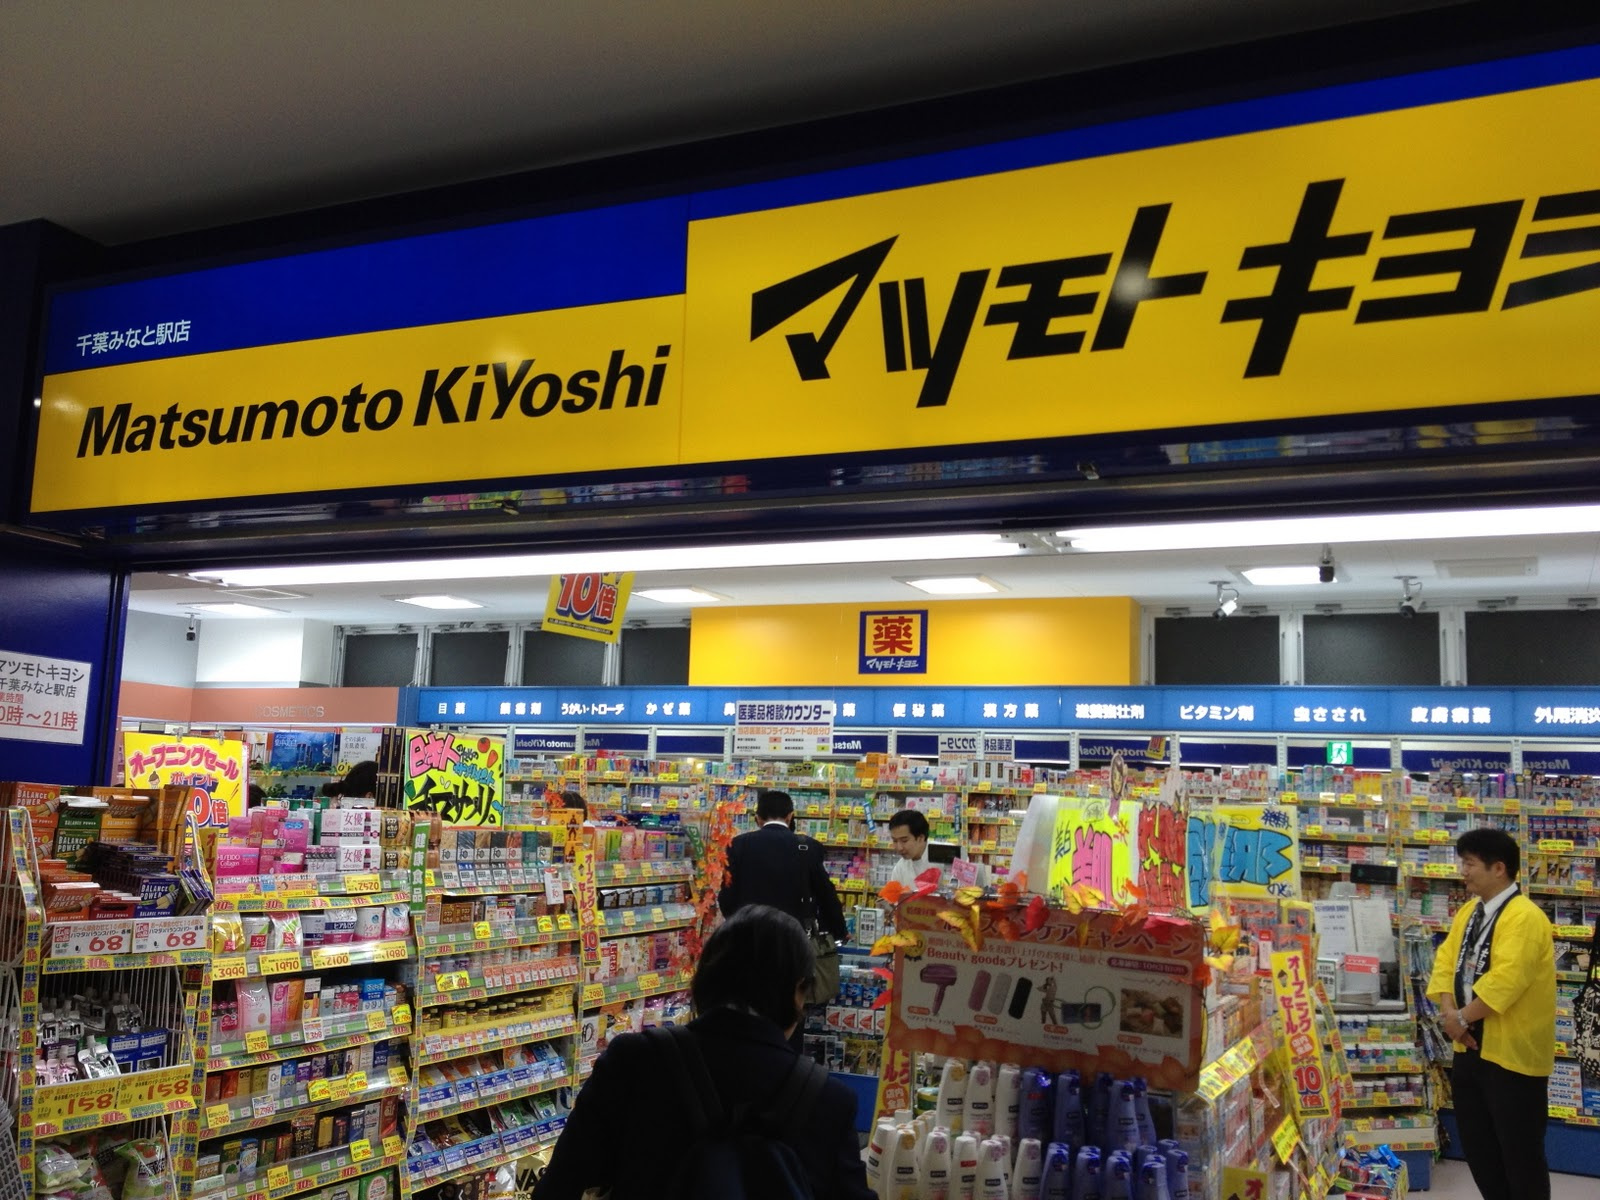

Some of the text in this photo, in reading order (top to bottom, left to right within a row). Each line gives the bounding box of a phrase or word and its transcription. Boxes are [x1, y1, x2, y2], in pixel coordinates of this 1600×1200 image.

[750, 178, 1600, 408] マツモトキヨシ
[76, 319, 191, 357] 千葉みなと駅店
[76, 343, 674, 458] Matsumoto KiYoshi
[872, 615, 914, 655] 薬
[0, 659, 85, 684] マツモトキヨシ
[866, 657, 919, 672] マツモトキヨシ
[0, 676, 77, 699] 千葉みなと駅店
[437, 702, 466, 714] 目薬
[561, 702, 625, 716] うがい・トローチ
[646, 702, 691, 717] かぜ薬
[738, 704, 831, 721] 医薬品相談カウンター
[892, 702, 945, 718] 便秘薬
[983, 703, 1039, 718] 漢方薬
[1179, 704, 1255, 722] ビタミン剤
[1293, 706, 1367, 723] 虫さされ
[129, 744, 239, 781] オープニングセール
[409, 731, 462, 778] 日本人
[170, 771, 219, 786] ポイント
[16, 798, 41, 806] POWER
[17, 788, 48, 800] BALANCE
[344, 811, 363, 827] 女優
[57, 843, 81, 853] POWER
[58, 836, 87, 845] BALANCE
[343, 849, 363, 864] 女優
[411, 832, 427, 904] 健康食品
[140, 883, 169, 894] BALANCE
[358, 881, 380, 892] 2520
[584, 853, 596, 909] オープニング
[52, 893, 84, 902] BALANCE
[140, 891, 163, 900] POWER
[577, 881, 588, 910] セール
[89, 934, 124, 953] 68
[166, 931, 198, 948] 68
[582, 931, 599, 950] 10
[326, 955, 349, 967] 2100
[385, 948, 406, 960] 1980
[927, 947, 967, 961] Beauty
[218, 965, 245, 979] 3999
[1287, 955, 1312, 1033] オープニング
[1279, 995, 1299, 1035] セール
[42, 1026, 56, 1039] in
[1293, 1065, 1324, 1094] 10
[147, 1079, 189, 1101] 158
[67, 1092, 114, 1115] 158
